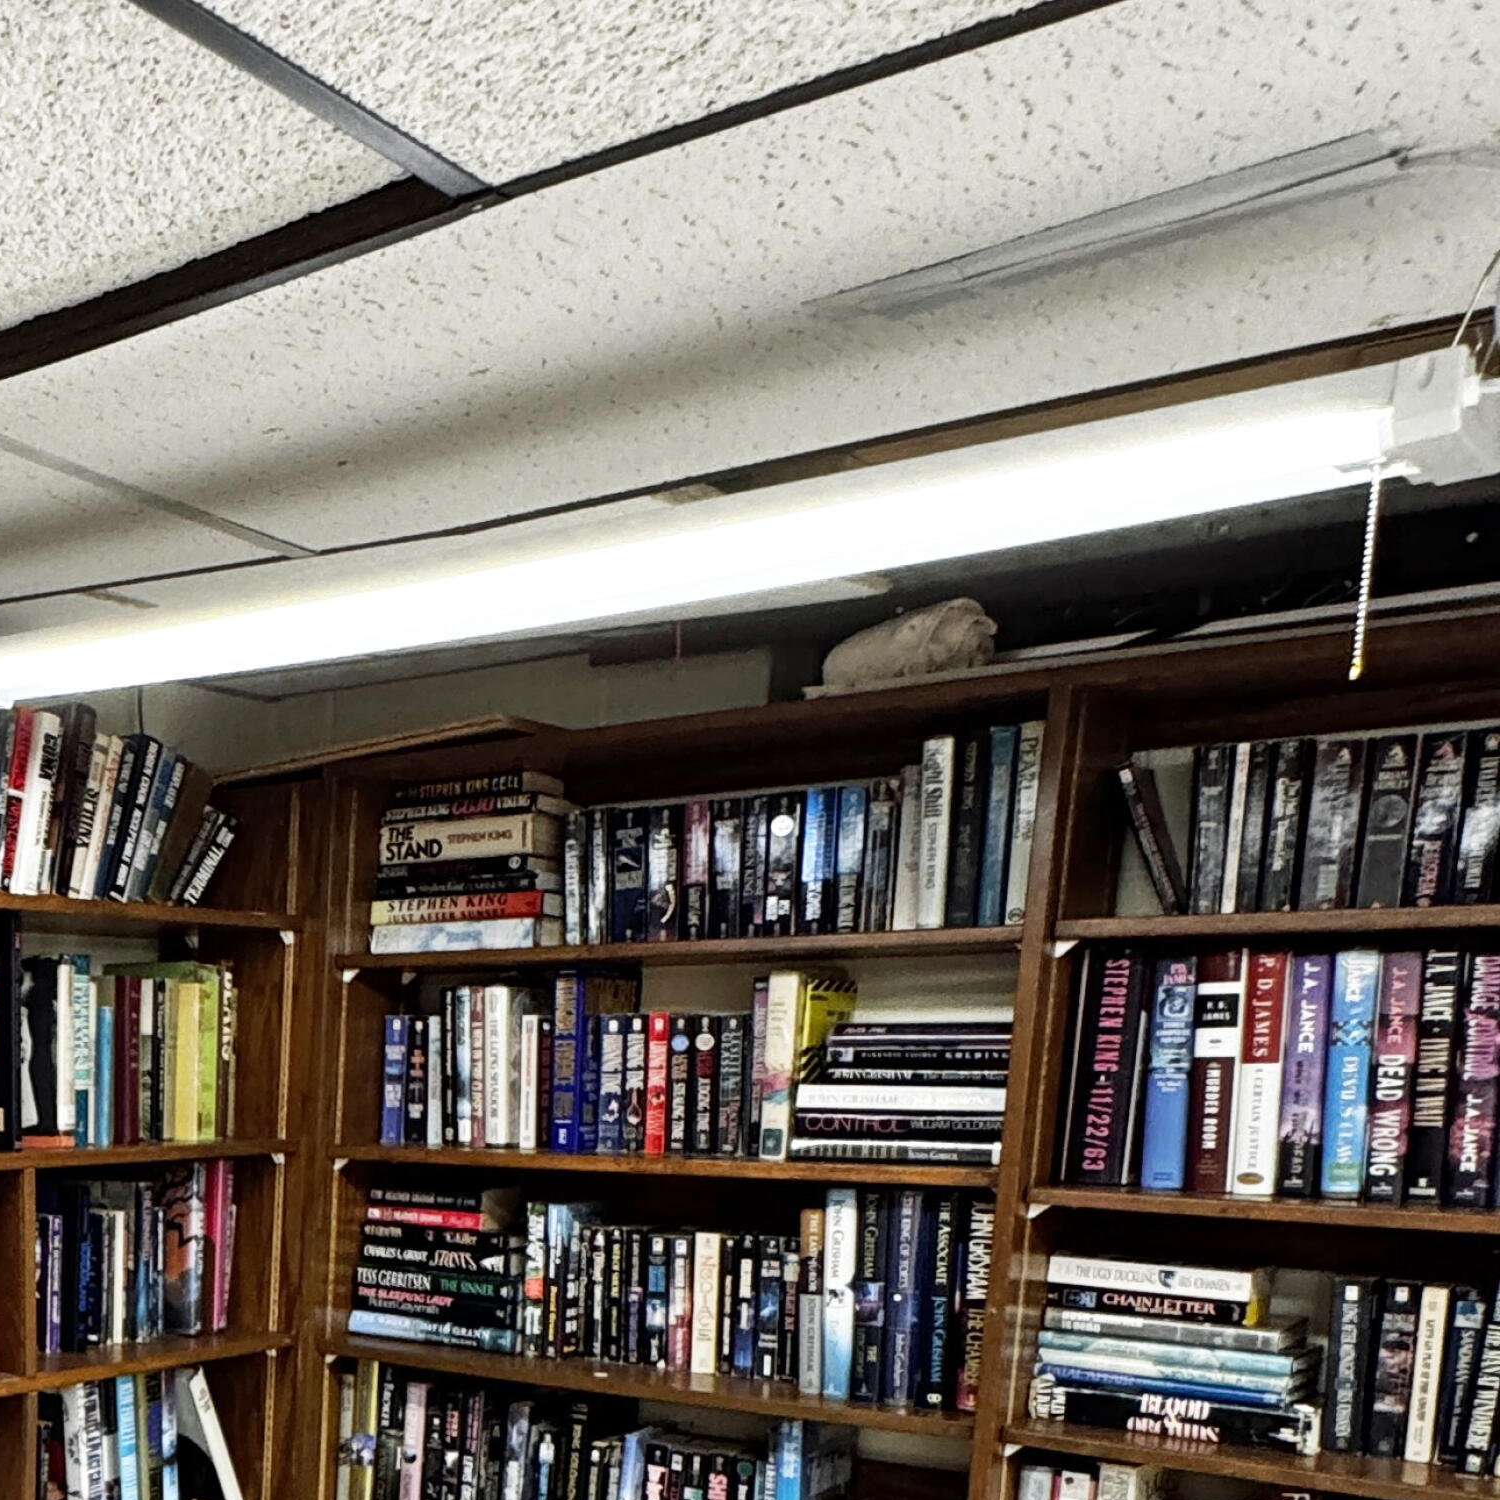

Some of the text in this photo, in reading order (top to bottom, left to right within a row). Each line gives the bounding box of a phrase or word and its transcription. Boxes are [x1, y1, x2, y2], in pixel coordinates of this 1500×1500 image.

[492, 775, 519, 789] CELL
[389, 825, 414, 841] THE
[447, 829, 513, 844] STEPHEN KING
[386, 839, 442, 861] STAND
[387, 893, 508, 912] STEPHEN KING
[388, 912, 416, 923] JUST
[419, 910, 461, 922] AFTER
[1095, 959, 1129, 1073] STEPHEN KING
[1203, 1011, 1231, 1021] JAMES
[1251, 998, 1272, 1058] JAMES
[1297, 1000, 1317, 1053] JANCE
[1386, 996, 1406, 1044] JANCE
[1201, 1066, 1221, 1150] MURDER ROOM
[1368, 1053, 1405, 1177] DEAD WRONG
[1414, 1092, 1448, 1128] WAIT
[803, 1115, 950, 1133] CONTROL WILLIAM
[357, 1267, 431, 1292] TESS GERRITSEN
[965, 1247, 993, 1300] GRISHAM
[1102, 1292, 1215, 1316] CHAIN LETTER
[930, 1329, 946, 1382] GRISHAM
[1140, 1393, 1210, 1420] BLOOD
